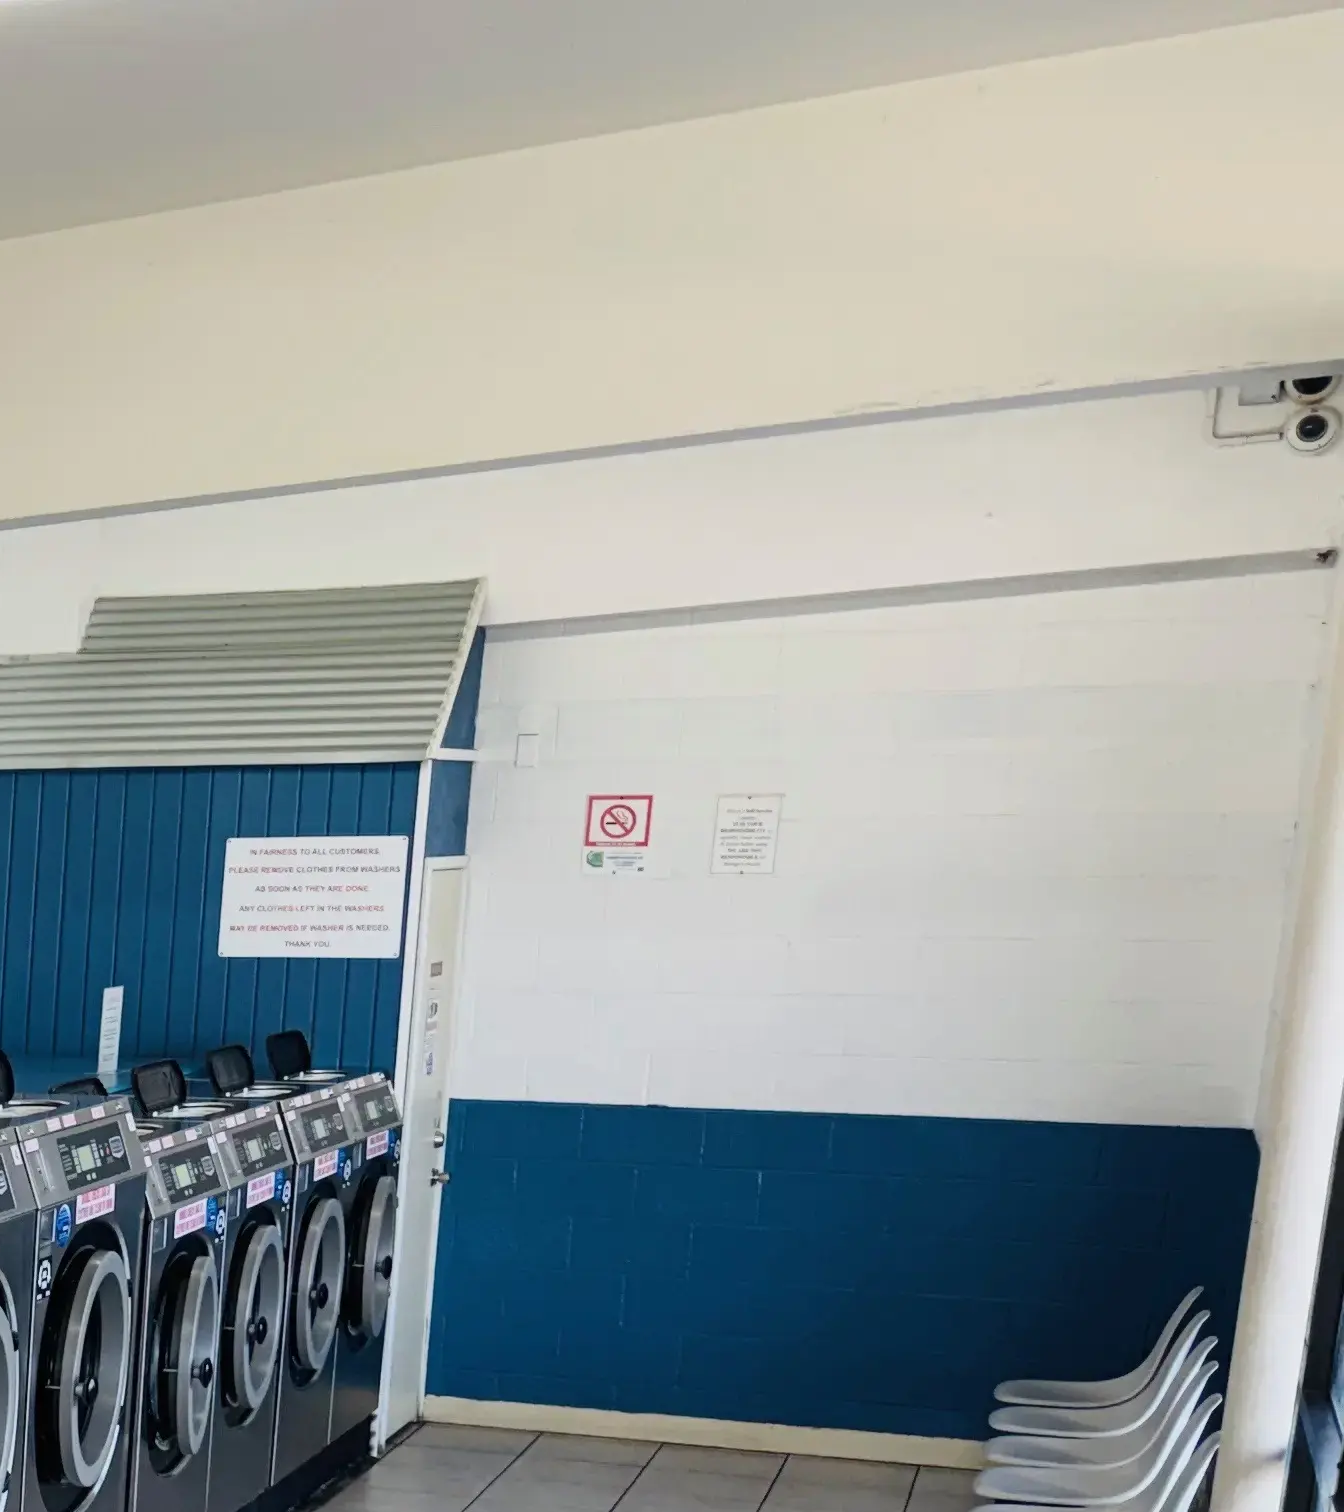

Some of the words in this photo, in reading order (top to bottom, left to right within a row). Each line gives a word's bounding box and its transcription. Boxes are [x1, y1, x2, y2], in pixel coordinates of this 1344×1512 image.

[249, 848, 258, 856] IN
[259, 848, 298, 856] FAIRNESS
[300, 848, 310, 856] TO
[312, 848, 326, 856] ALL
[228, 866, 259, 874] PLEASE
[261, 866, 294, 874] REMOVE
[296, 866, 334, 874] CLOTHES
[335, 865, 359, 873] FROM
[360, 865, 401, 873] WASHERS
[254, 885, 266, 893] AS
[267, 885, 291, 893] SOON
[292, 885, 303, 893] AS
[305, 885, 326, 893] THEY
[327, 885, 343, 893] ARE
[238, 905, 255, 913] ANY
[256, 905, 294, 913] CLOTHES
[295, 905, 315, 913] LEFT
[229, 925, 245, 933] MAY
[247, 925, 257, 933] BE
[259, 925, 299, 933] REMOVED
[284, 940, 311, 948] THANK
